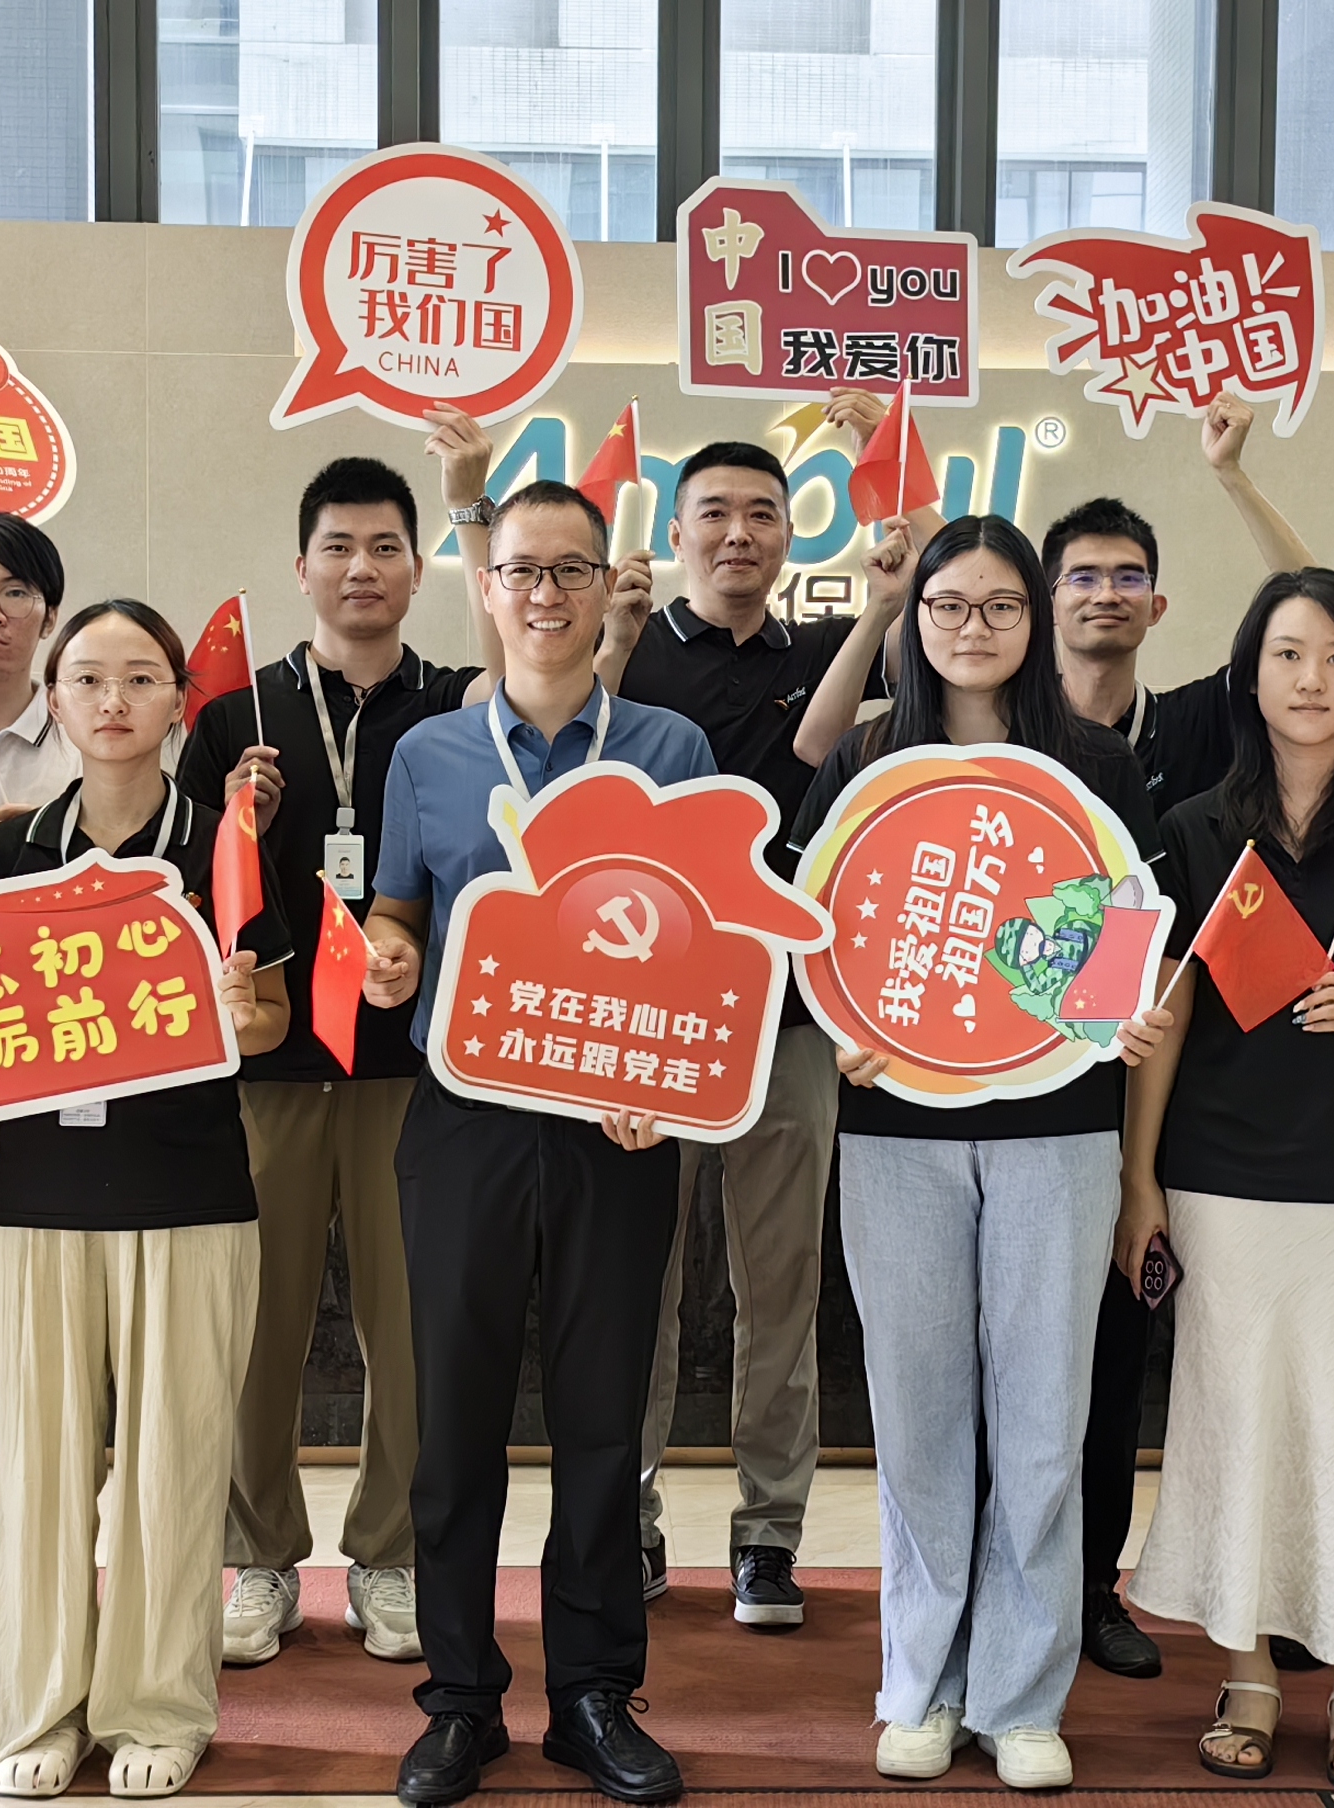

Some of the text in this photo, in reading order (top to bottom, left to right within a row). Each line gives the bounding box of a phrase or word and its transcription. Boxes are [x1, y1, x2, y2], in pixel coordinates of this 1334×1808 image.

[347, 230, 513, 294] 厉害了
[701, 207, 765, 376] 中国
[778, 250, 960, 307] I you
[358, 288, 523, 353] 我们国
[1166, 310, 1300, 397] 中国
[378, 351, 460, 378] CHINA
[780, 327, 961, 383] 我爱你
[934, 803, 1015, 989] 祖国万岁
[877, 840, 957, 1027] 我爱祖国
[508, 979, 709, 1046] 党在我心中
[496, 1027, 701, 1095] 永远跟党走
